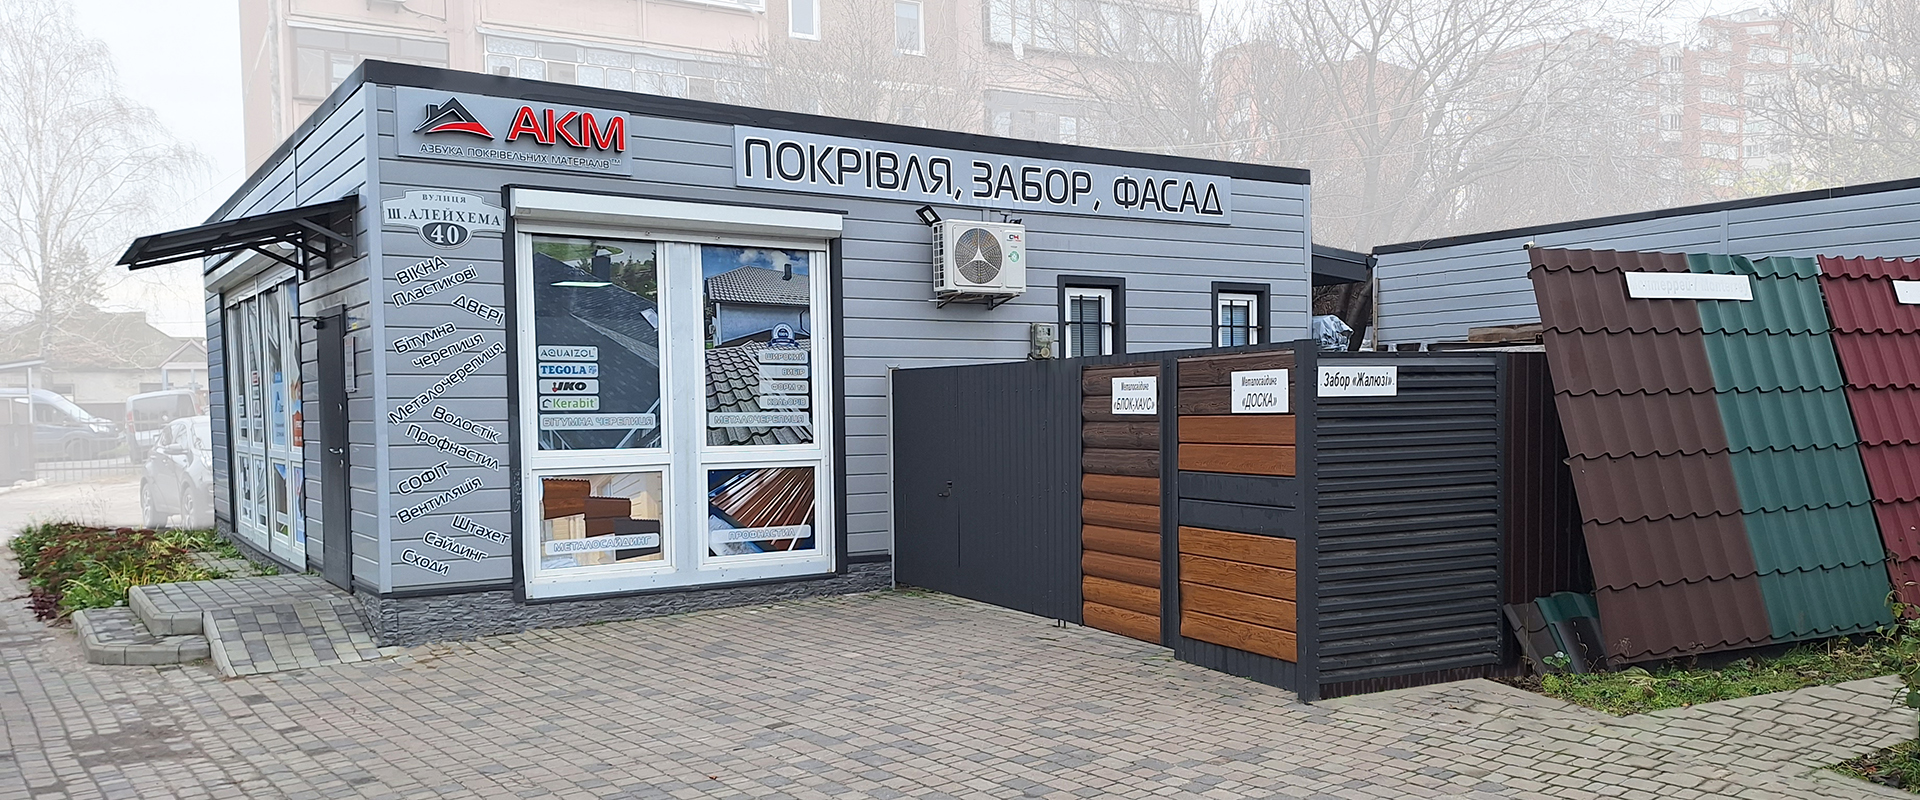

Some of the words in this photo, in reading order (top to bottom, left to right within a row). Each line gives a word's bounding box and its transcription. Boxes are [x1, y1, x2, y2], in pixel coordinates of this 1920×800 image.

[505, 105, 626, 153] АКМ
[420, 143, 464, 157] АЗБУКА
[467, 147, 549, 164] ПОКРІВЕЛЬНИХ
[744, 137, 963, 201] ПОКРІВЛЯ,
[972, 161, 1102, 212] ЗАБОР,
[1113, 175, 1225, 217] ФАСАД
[422, 193, 467, 204] ВУЛИЦЯ
[387, 207, 501, 227] Ш.АЛЕЙХЕМА
[430, 224, 460, 245] 40
[396, 256, 448, 285] ВІКНА
[392, 265, 478, 308] Пластикові
[451, 294, 505, 325] ДВЕРІ
[393, 322, 456, 354] Бітумна
[412, 333, 485, 368] черепиця
[388, 342, 505, 425] Металочерепиця
[540, 365, 587, 375] TEGOLA
[1323, 371, 1351, 391] Забор
[553, 398, 595, 409] Kerabit
[432, 405, 502, 444] Водостік
[543, 416, 594, 427] БІТУМНА
[596, 416, 654, 427] ЧЕРЕПИЦЯ
[713, 414, 805, 425] МЕТАЛОЧЕРЕПИЦЯ
[405, 423, 500, 471] Профнастил
[397, 461, 450, 494] СОФІТ
[396, 477, 484, 524] Вентиляція
[451, 514, 511, 545] Штахет
[553, 535, 652, 552] МЕТАЛОСАЙДИНГ
[728, 528, 796, 541] ПРОФНАСТИЛ
[423, 530, 488, 562] Сайдинг
[401, 549, 450, 576] Сходи
